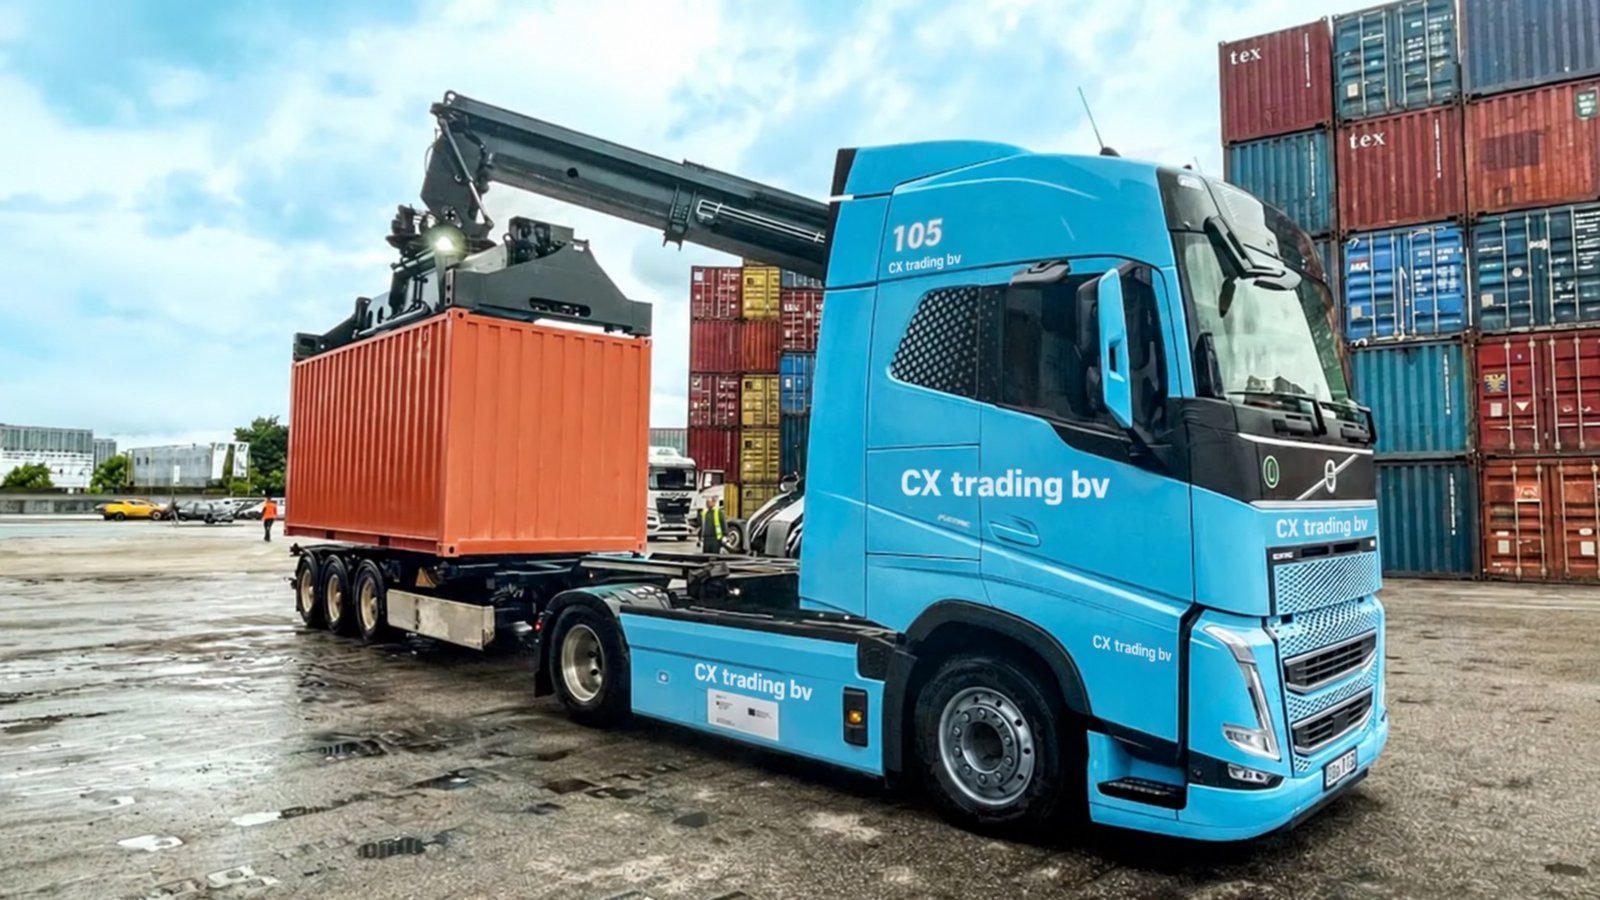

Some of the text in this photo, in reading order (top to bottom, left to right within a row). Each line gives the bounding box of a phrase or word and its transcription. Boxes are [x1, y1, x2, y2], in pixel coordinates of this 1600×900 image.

[1230, 48, 1262, 65] tex
[1349, 132, 1386, 150] tex
[893, 218, 943, 253] 105
[888, 251, 962, 274] CX trading bv
[901, 468, 1110, 506] CX trading bv
[1276, 515, 1367, 538] CX trading bv
[1092, 634, 1172, 662] CX trading bv
[694, 662, 813, 702] CX trading bv
